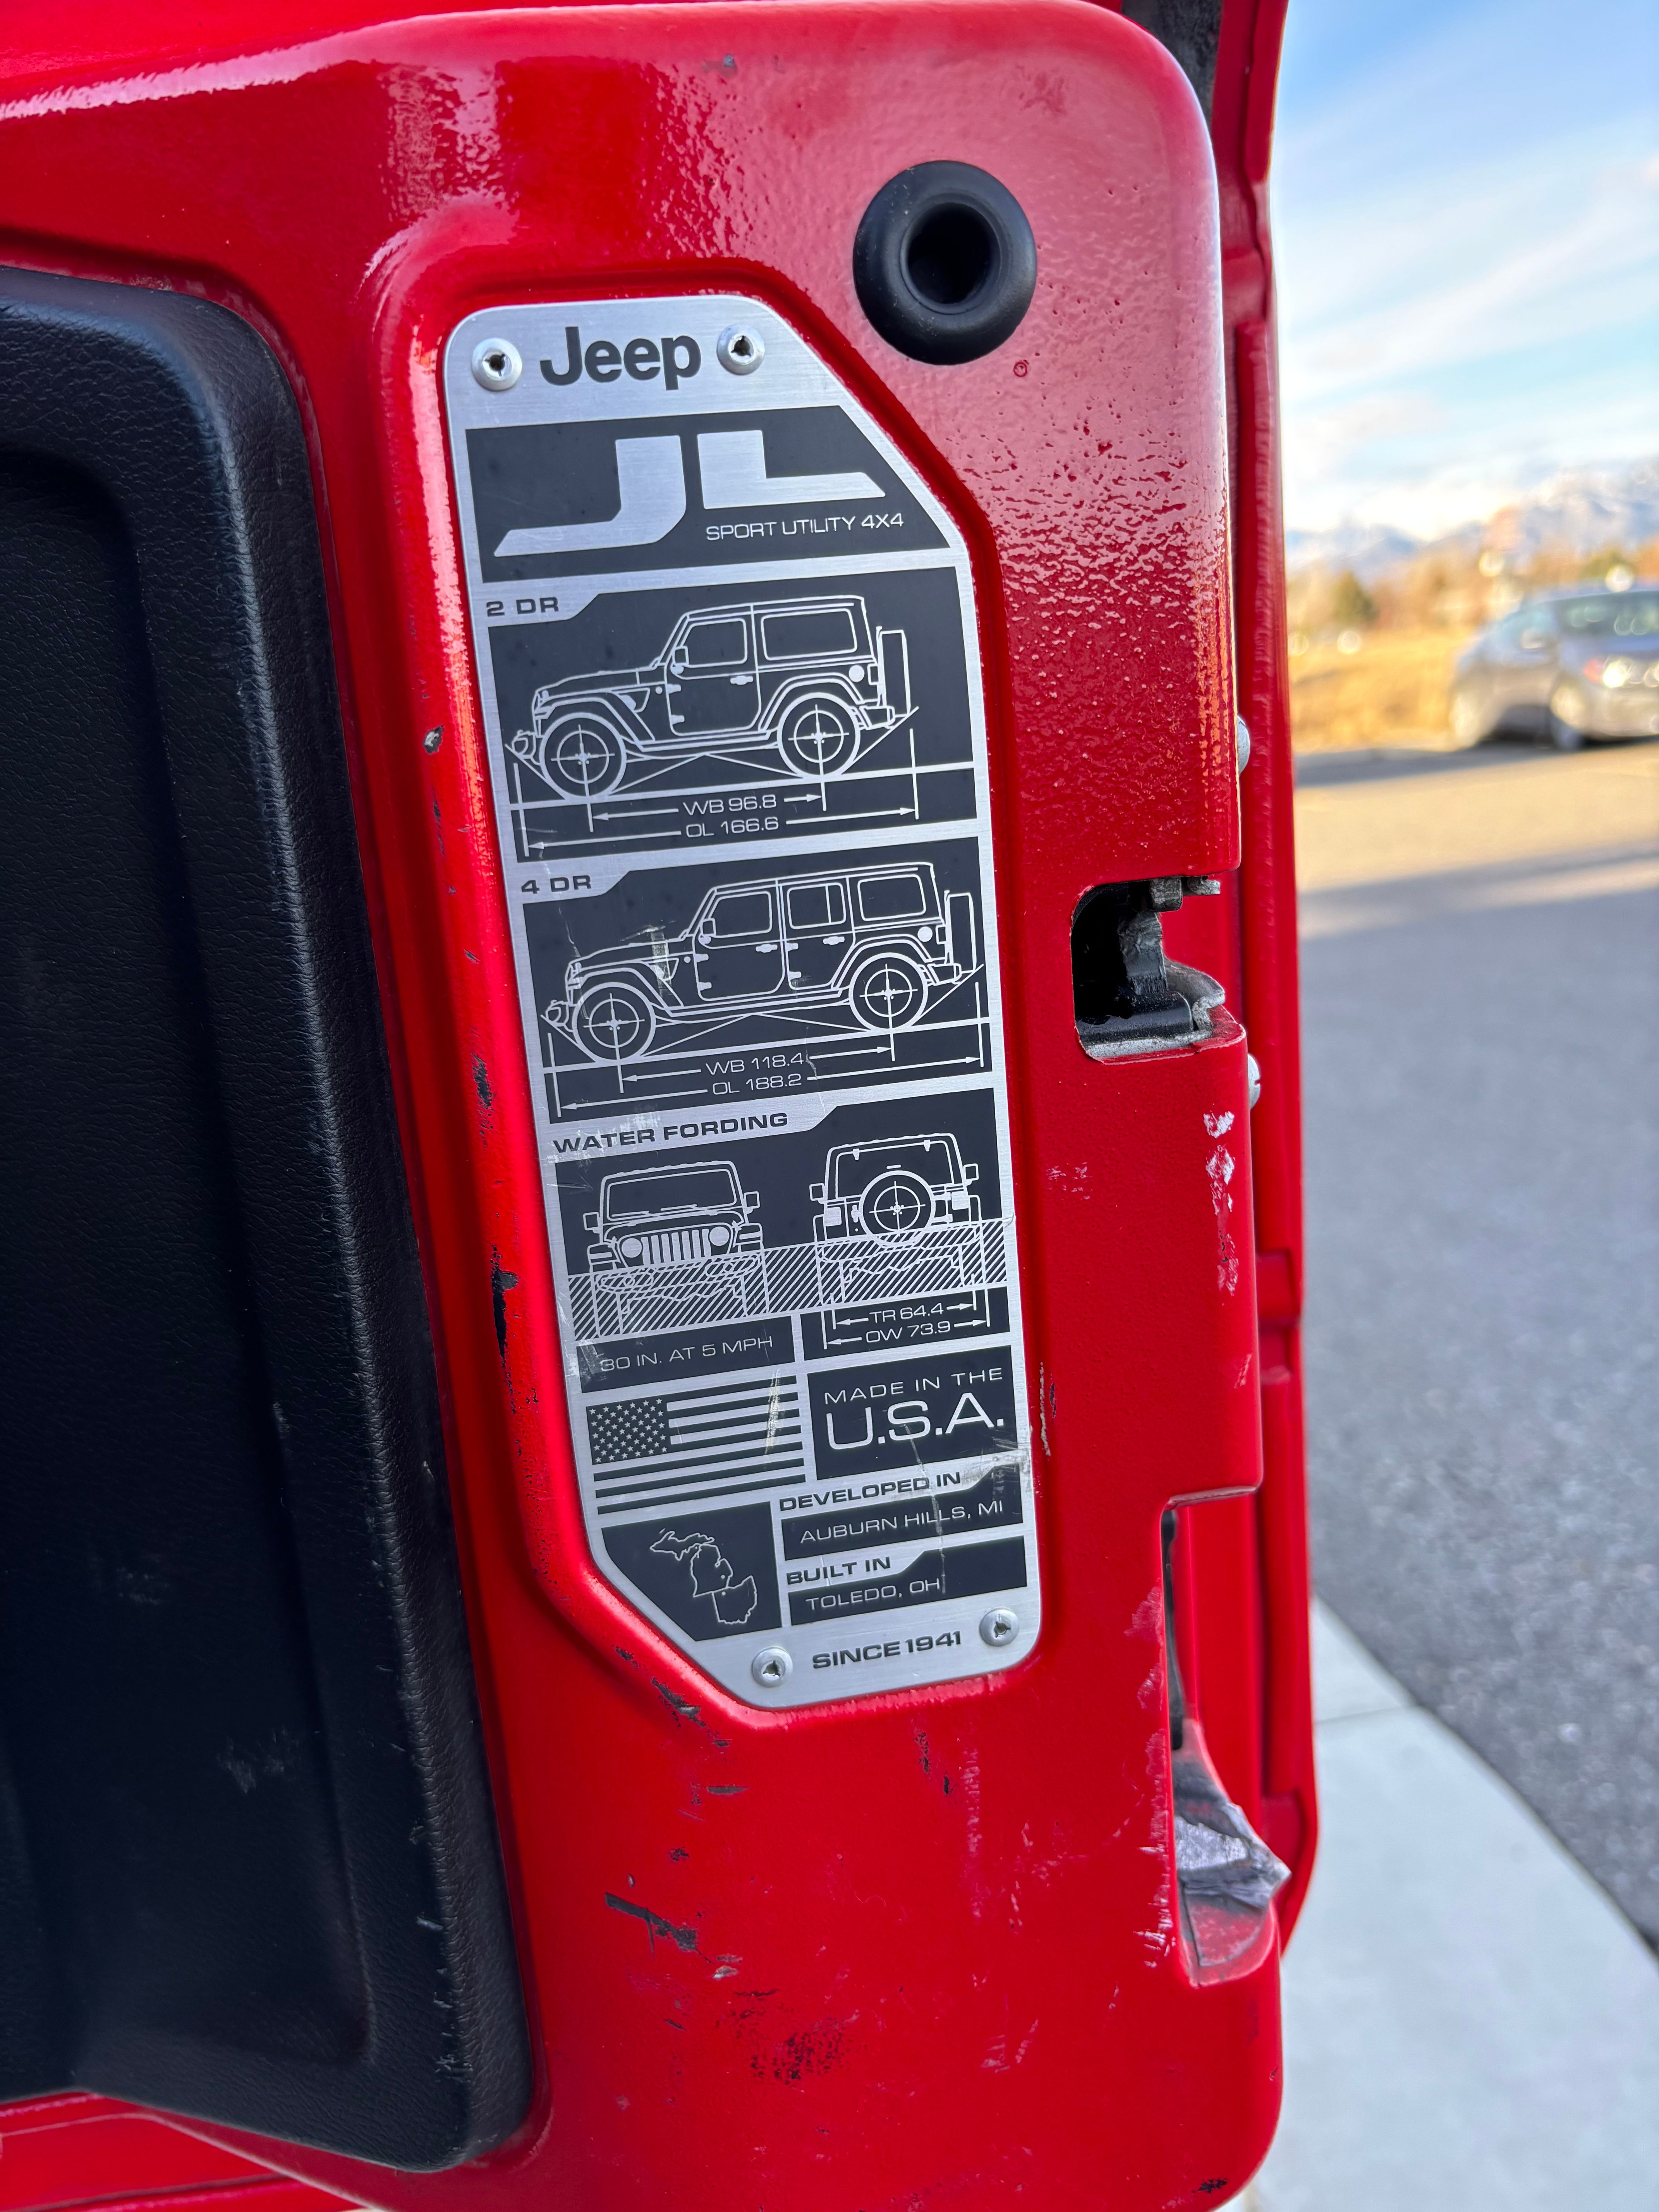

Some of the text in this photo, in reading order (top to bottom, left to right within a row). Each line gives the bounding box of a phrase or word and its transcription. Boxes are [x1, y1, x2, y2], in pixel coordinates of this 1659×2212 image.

[540, 327, 701, 390] Jeep
[494, 430, 886, 557] JL
[706, 513, 904, 541] SPORT UTILITY 4X4
[486, 597, 559, 617] 2 DR
[683, 794, 776, 815] WB 96.8
[686, 817, 779, 838] OL 166.6
[521, 875, 591, 894] 4 DR
[706, 1052, 804, 1075] WB 118.4
[713, 1073, 802, 1095] OL 188.2
[553, 1113, 788, 1153] WATER FORDING
[869, 1302, 944, 1323] TR 64.4
[866, 1321, 951, 1343] OW 73.9
[601, 1336, 773, 1371] 30 IN. AT 5 MPH
[824, 1367, 1003, 1405] MADE IN THE
[826, 1393, 1004, 1450] U.S.A.
[779, 1472, 960, 1511] DEVELOPED IN
[800, 1500, 1003, 1544] AUBURN HILLS, MI
[787, 1556, 891, 1585] BUILT IN
[805, 1578, 939, 1610] TOLEDO, OH
[812, 1630, 961, 1669] SINCE 1941
